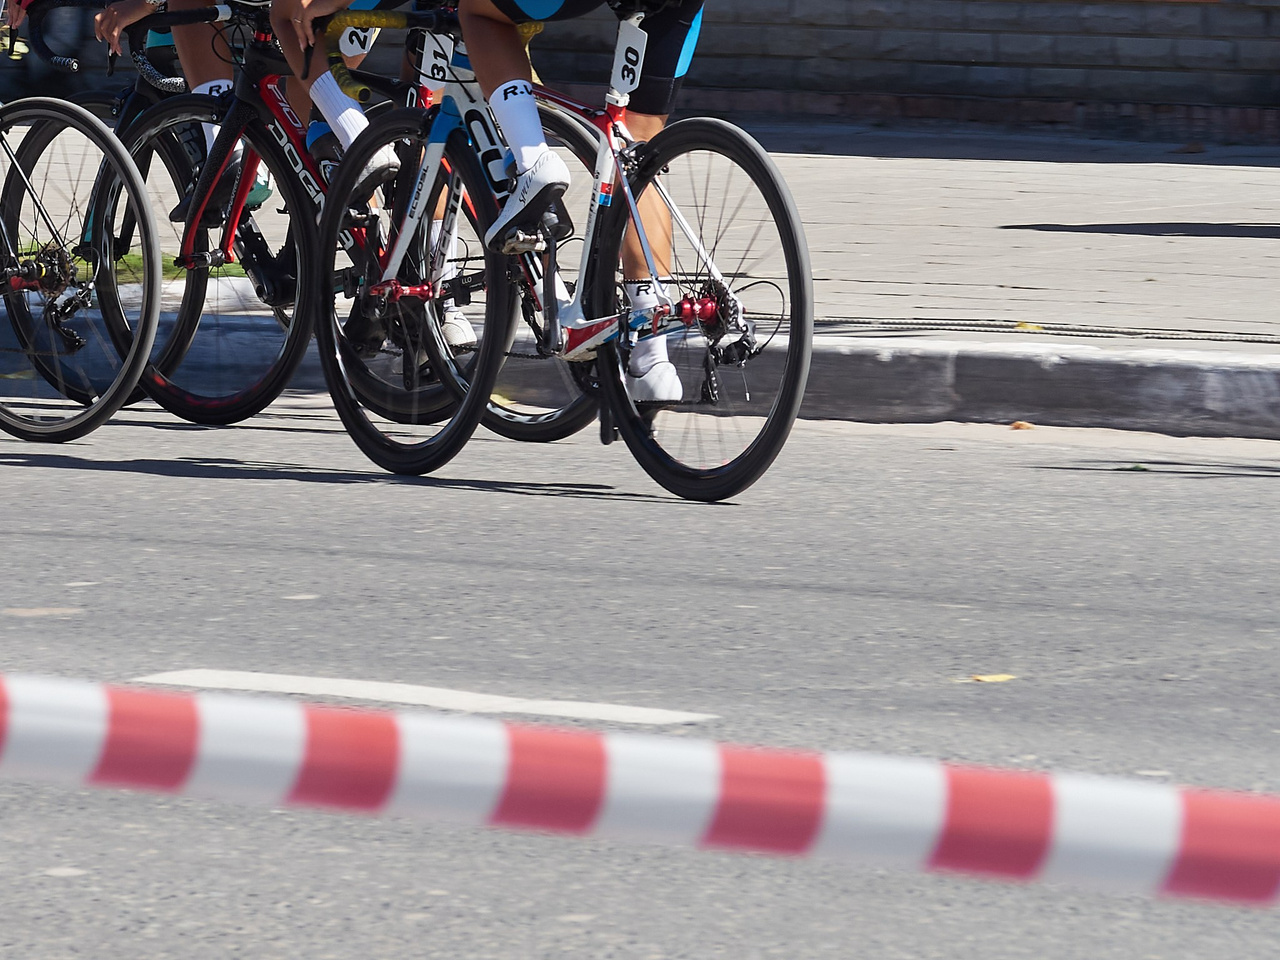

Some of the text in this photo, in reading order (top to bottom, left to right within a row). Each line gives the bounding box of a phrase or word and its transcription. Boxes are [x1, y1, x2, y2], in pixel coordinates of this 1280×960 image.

[430, 50, 448, 80] 31
[621, 45, 640, 86] 30
[409, 164, 430, 219] EC90SL
